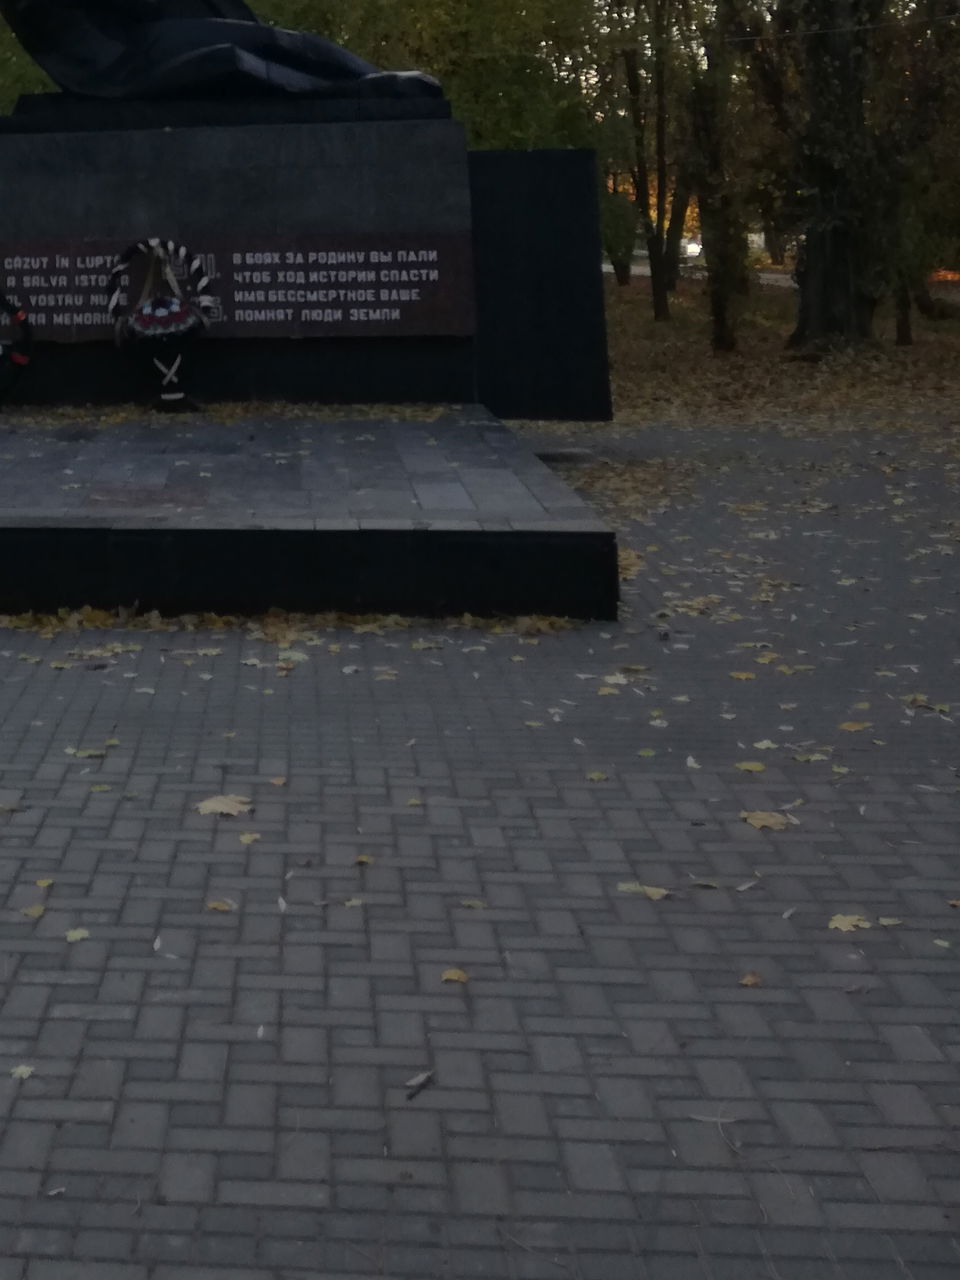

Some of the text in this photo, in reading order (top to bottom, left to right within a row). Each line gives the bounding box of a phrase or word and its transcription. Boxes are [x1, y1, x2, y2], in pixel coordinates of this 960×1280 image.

[232, 250, 438, 265] В БОЯХ ЗА РОДИНУ ВЫ ПАЛИ
[22, 275, 67, 288] SALVA
[75, 274, 129, 287] ISTOA
[234, 269, 439, 284] ЧТОБ ХОД ИСТОРИИ СПАСТИ
[29, 293, 83, 307] VOSTRU
[90, 293, 128, 306] NUE
[234, 289, 421, 302] ИМЯ БЕССМЕРТНОЕ ВАШЕ
[235, 308, 294, 322] ПОМНЯТ
[301, 308, 343, 322] ЛЮДИ
[349, 308, 401, 321] ЗЕМЛИ
